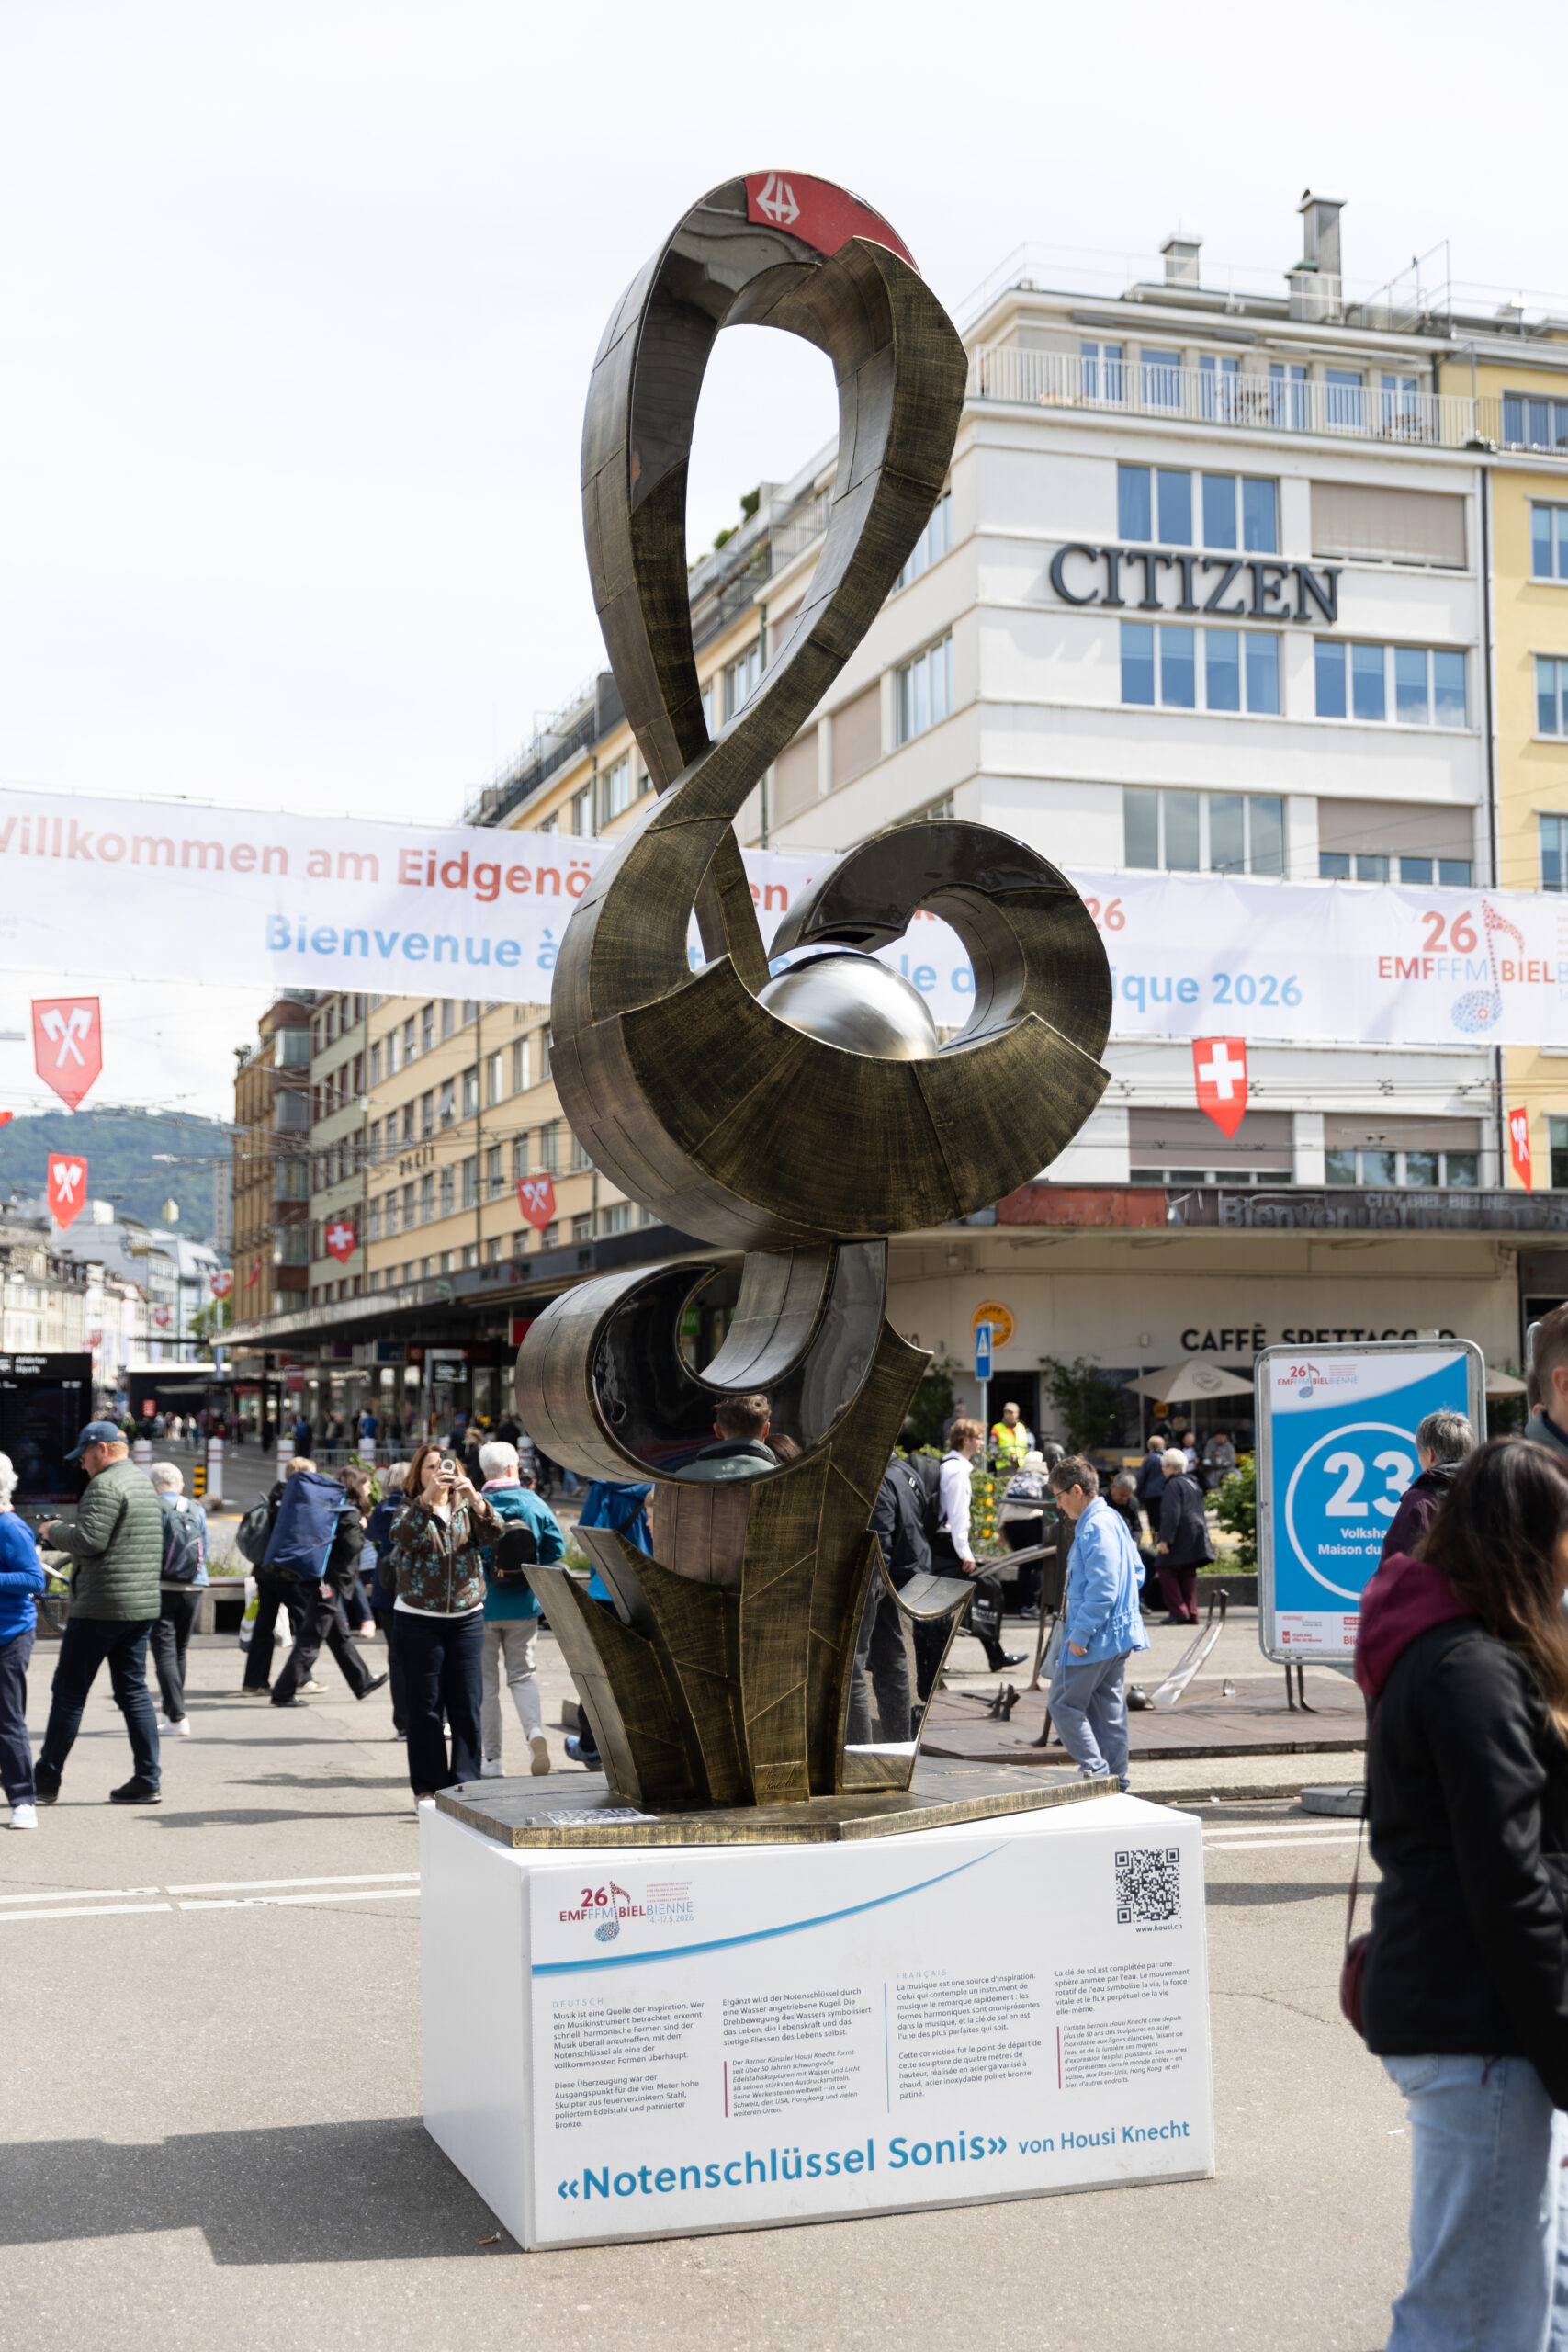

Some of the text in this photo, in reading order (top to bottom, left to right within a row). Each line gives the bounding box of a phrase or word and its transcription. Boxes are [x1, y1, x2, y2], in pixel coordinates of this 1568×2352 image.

[1050, 543, 1343, 622] CITIZEN
[306, 849, 379, 882] am
[1421, 910, 1478, 953] 26
[265, 914, 521, 968] Bienvenue
[537, 928, 559, 969] à
[1213, 972, 1302, 1006] 2026
[1290, 1366, 1306, 1377] 26
[1323, 1450, 1415, 1517] 23
[1318, 1544, 1381, 1555] Maison du
[581, 1886, 608, 1908] 26
[1135, 1923, 1182, 1933] www.housi.ch
[896, 1969, 947, 1979] FRANÇAIS
[907, 1982, 938, 1991] musique
[991, 1973, 1035, 1983] d'inspiration.
[1056, 1979, 1079, 1988] sphère
[1081, 1976, 1106, 1984] animée
[1149, 1969, 1190, 1978] mouvement
[723, 1998, 751, 2007] Ergänzt
[784, 1990, 839, 2001] Notenschlüssel
[840, 1988, 862, 1996] durch
[897, 1993, 915, 2001] Celui
[917, 1992, 929, 2001] qui
[930, 1989, 968, 1998] contemple
[980, 1984, 1018, 1993] instrument
[552, 1998, 604, 2008] DEUTSCH
[769, 2003, 818, 2013] angetriebene
[819, 1999, 841, 2009] Kugel.
[924, 2008, 970, 2018] harmoniques
[989, 2002, 1040, 2012] omniprésentes
[1056, 2006, 1095, 2015] elle-même.
[553, 2012, 576, 2020] Musik
[606, 2007, 631, 2016] Quelle
[647, 2003, 687, 2013] Inspiration.
[723, 2016, 780, 2026] Drehbewegung
[828, 2007, 871, 2018] symbolisiert
[567, 2018, 630, 2029] Musikinstrument
[632, 2014, 672, 2023] betrachtet,
[674, 2012, 702, 2020] erkennt
[778, 2021, 821, 2031] Lebenskraft
[554, 2031, 582, 2040] schnell:
[584, 2027, 632, 2037] harmonische
[554, 2041, 577, 2049] Musik
[578, 2039, 605, 2047] überall
[606, 2036, 651, 2045] anzutreffen,
[724, 2038, 749, 2046] stetige
[554, 2048, 611, 2059] Notenschlüssel
[554, 2059, 616, 2069] vollkommensten
[648, 2052, 688, 2061] überhaupt.
[577, 2078, 628, 2087] Überzeugung
[733, 2072, 796, 2083] Edelstahlskulpturen
[900, 2080, 923, 2089] chaud,
[944, 2075, 983, 2085] inoxydable
[984, 2073, 997, 2082] poli
[555, 2088, 614, 2100] Ausgangspunkt
[555, 2101, 587, 2109] Skulptur
[604, 2094, 664, 2105] feuerverzinktem
[666, 2091, 686, 2099] Stahl,
[555, 2110, 592, 2121] poliertem
[594, 2106, 628, 2115] Edelstahl
[646, 2102, 685, 2112] patinierter
[558, 2120, 1190, 2199] «Notenschlüssel Sonis» von Housi Knecht
